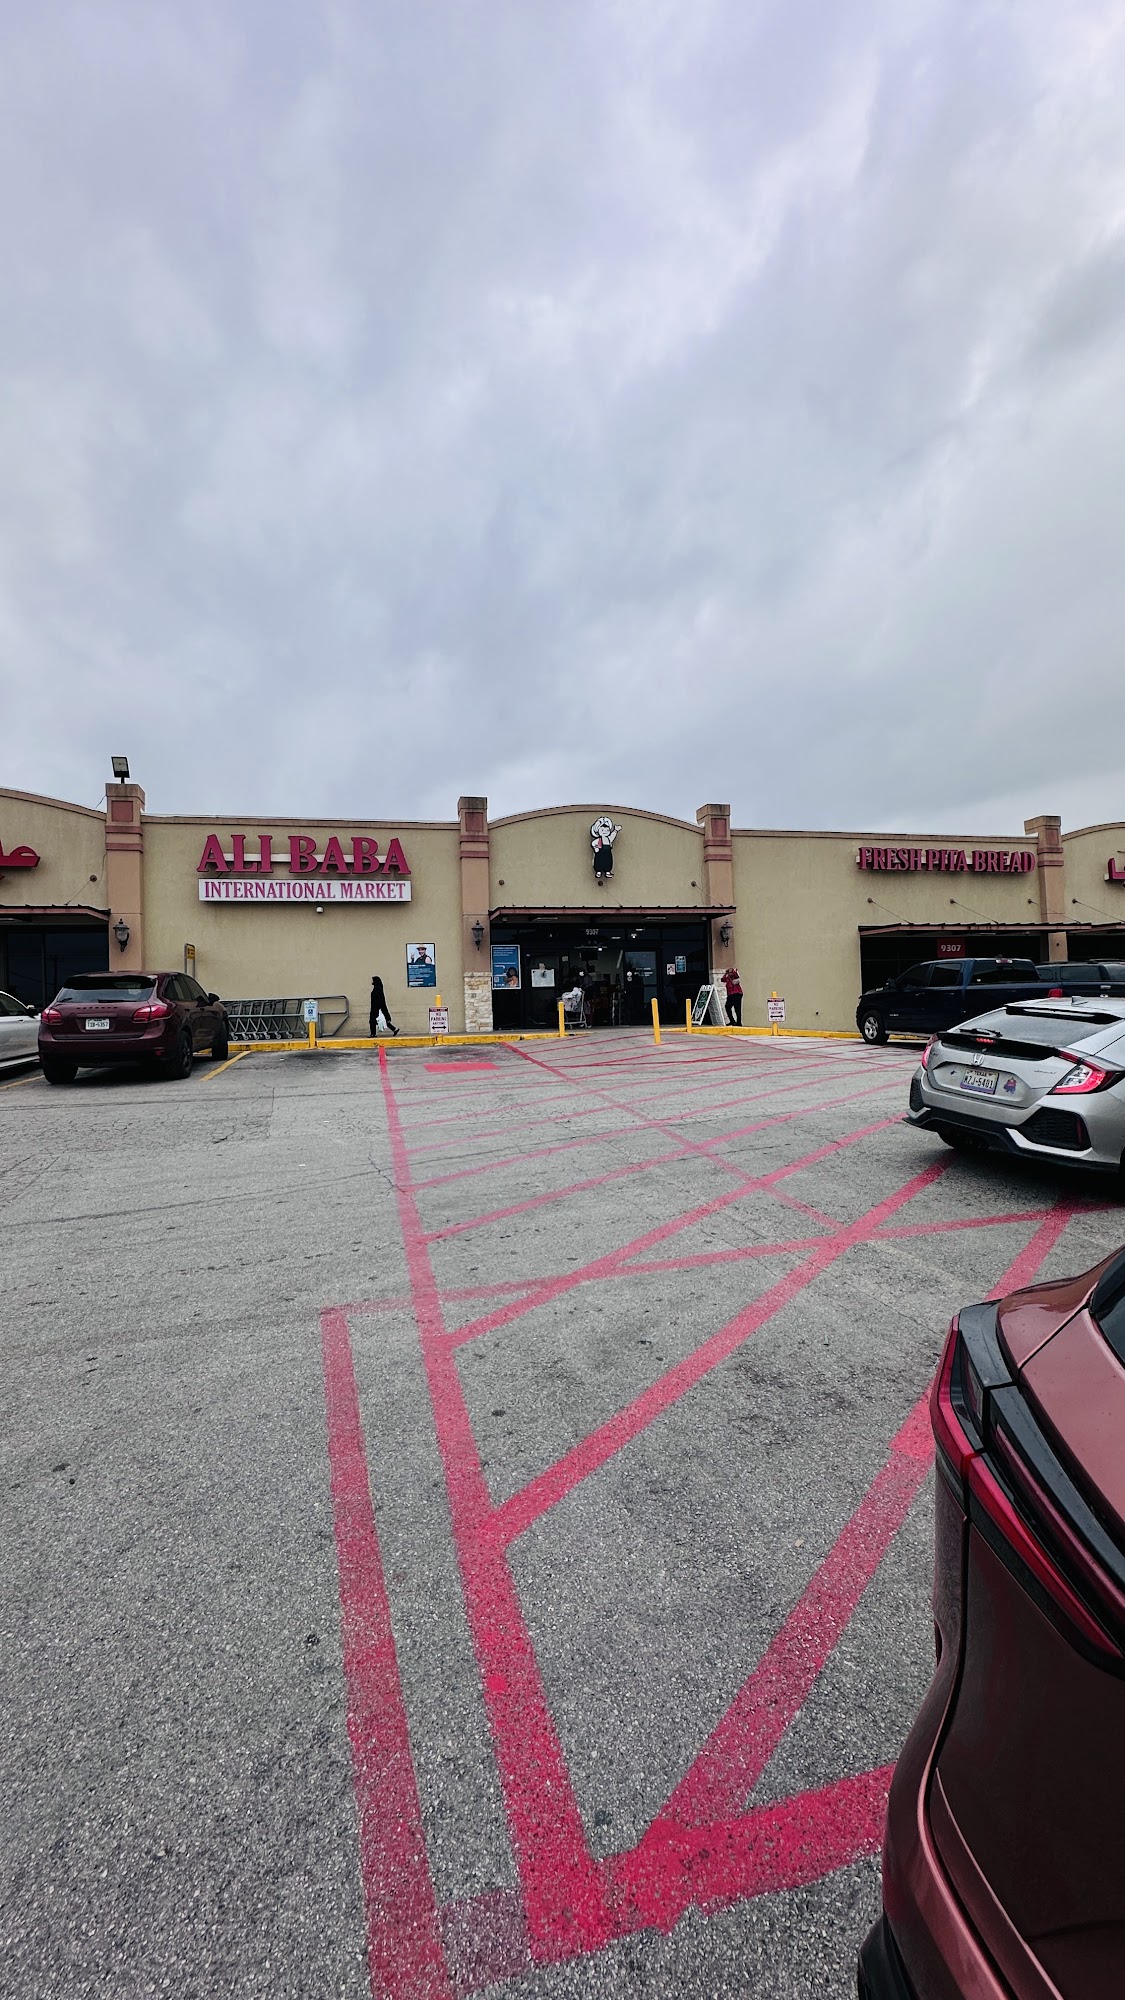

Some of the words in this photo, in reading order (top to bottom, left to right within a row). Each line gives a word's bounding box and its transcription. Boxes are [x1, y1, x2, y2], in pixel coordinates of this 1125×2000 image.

[197, 834, 274, 873] ALI
[288, 835, 411, 874] BABA
[859, 847, 922, 871] FRESH
[925, 849, 969, 872] PITA
[972, 850, 1036, 873] BREAD
[204, 881, 336, 899] INTERNATIONAL
[340, 883, 406, 899] MARKET
[940, 944, 961, 952] 9307
